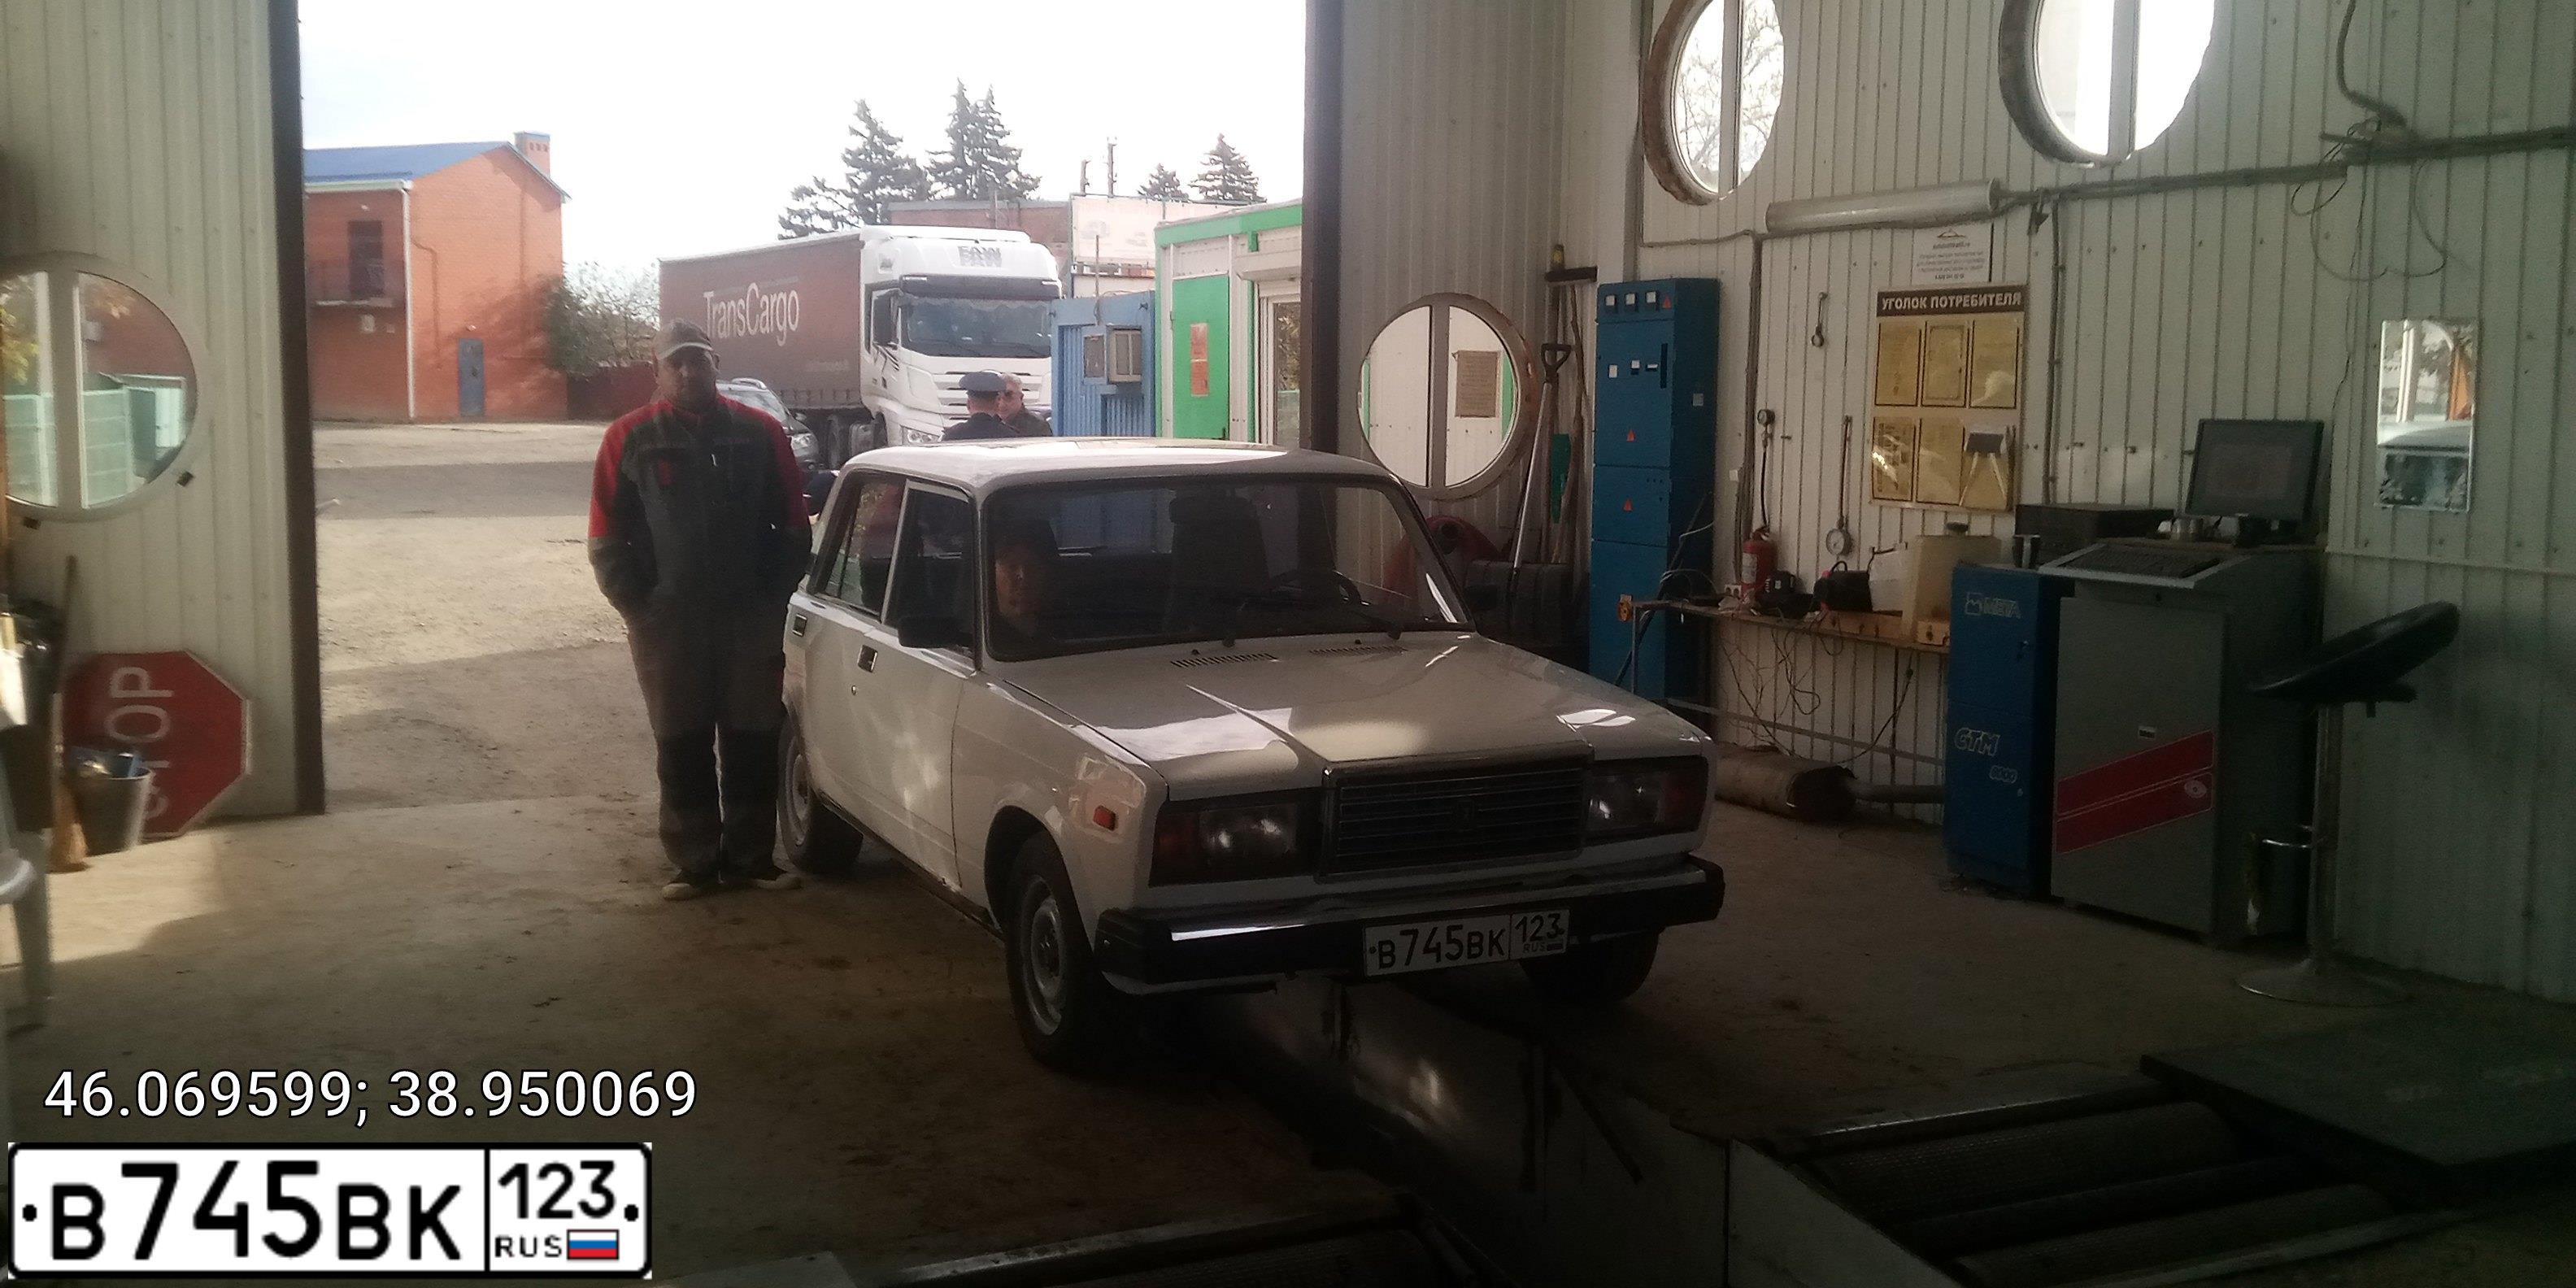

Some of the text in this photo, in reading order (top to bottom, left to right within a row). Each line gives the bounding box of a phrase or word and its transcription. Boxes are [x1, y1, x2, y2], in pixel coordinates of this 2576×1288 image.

[1882, 293, 2021, 310] УГОЛОК ПОТРЕБИТЕЛЯ
[703, 281, 800, 346] TransCargo
[1515, 913, 1564, 943] 123
[1523, 940, 1546, 953] RUS
